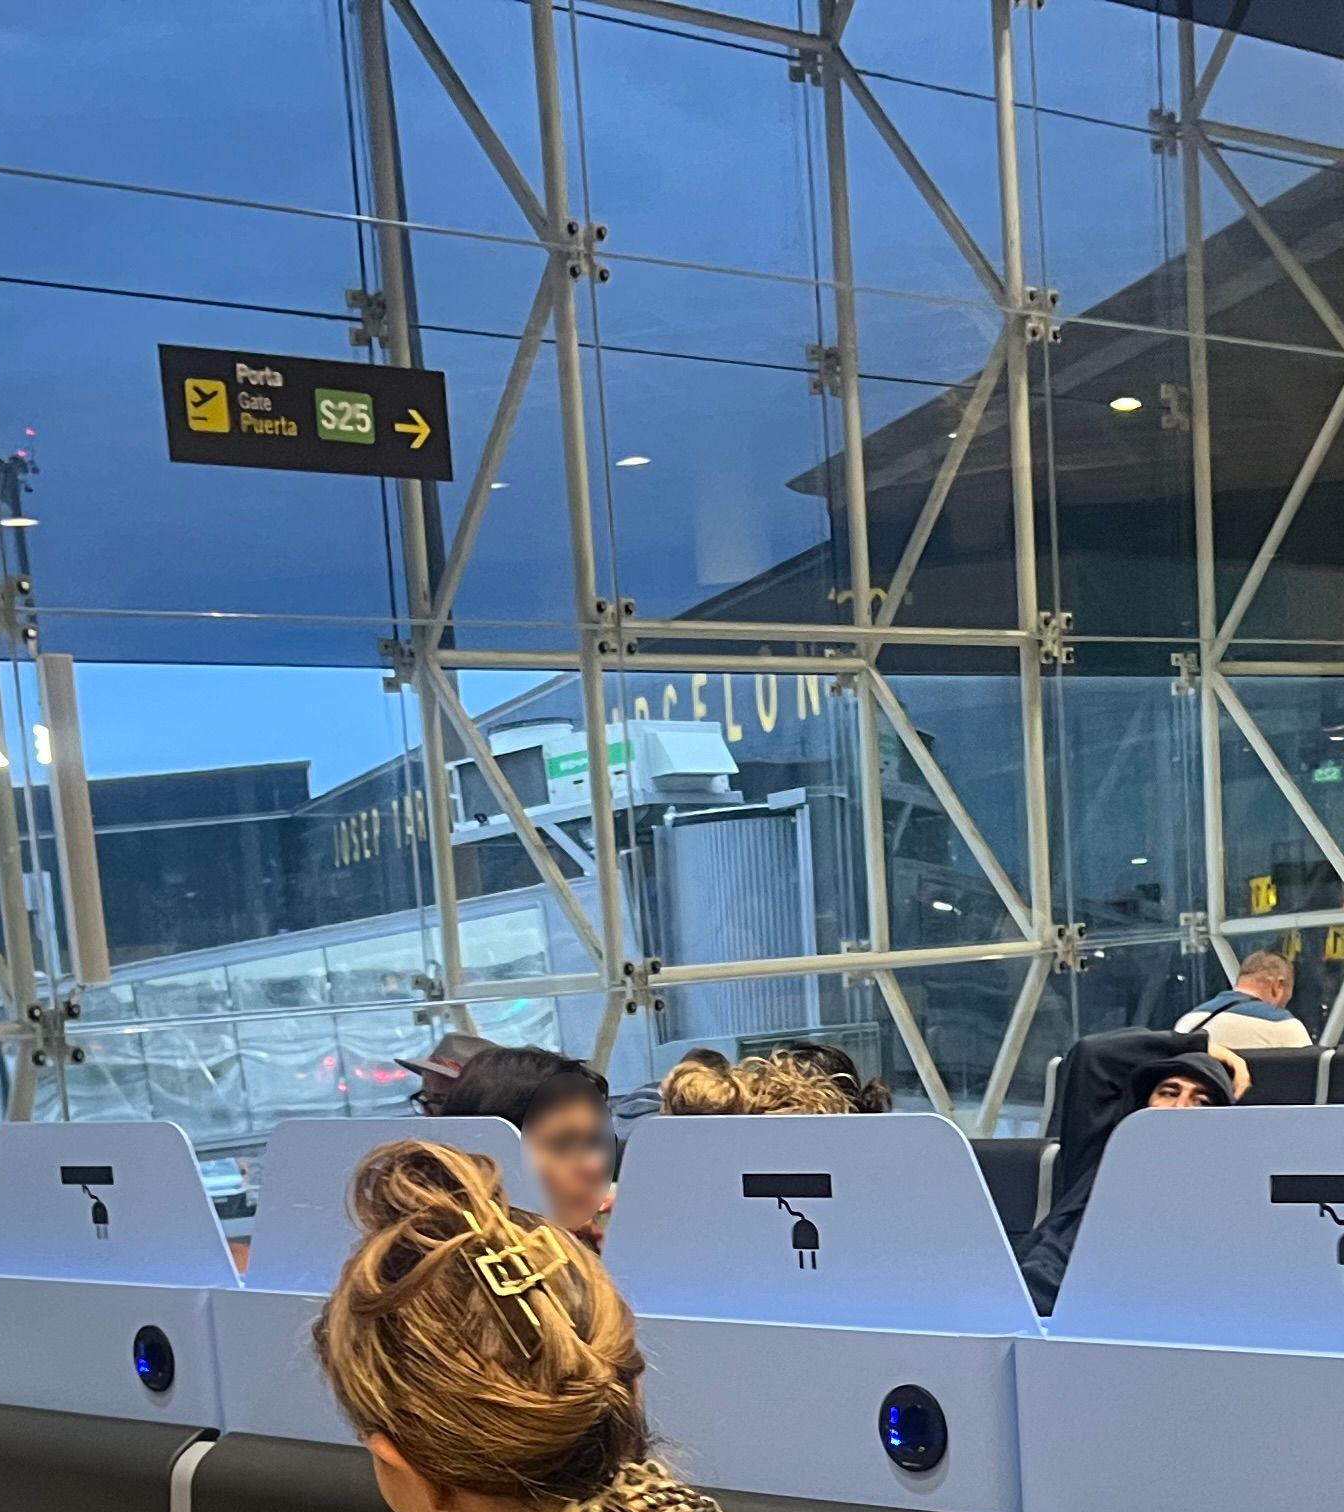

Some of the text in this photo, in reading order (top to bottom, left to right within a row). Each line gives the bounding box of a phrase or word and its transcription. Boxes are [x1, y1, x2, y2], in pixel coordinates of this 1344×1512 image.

[236, 363, 283, 387] Porta
[238, 391, 273, 412] Gate
[241, 412, 298, 437] Puerta
[320, 399, 372, 433] S25
